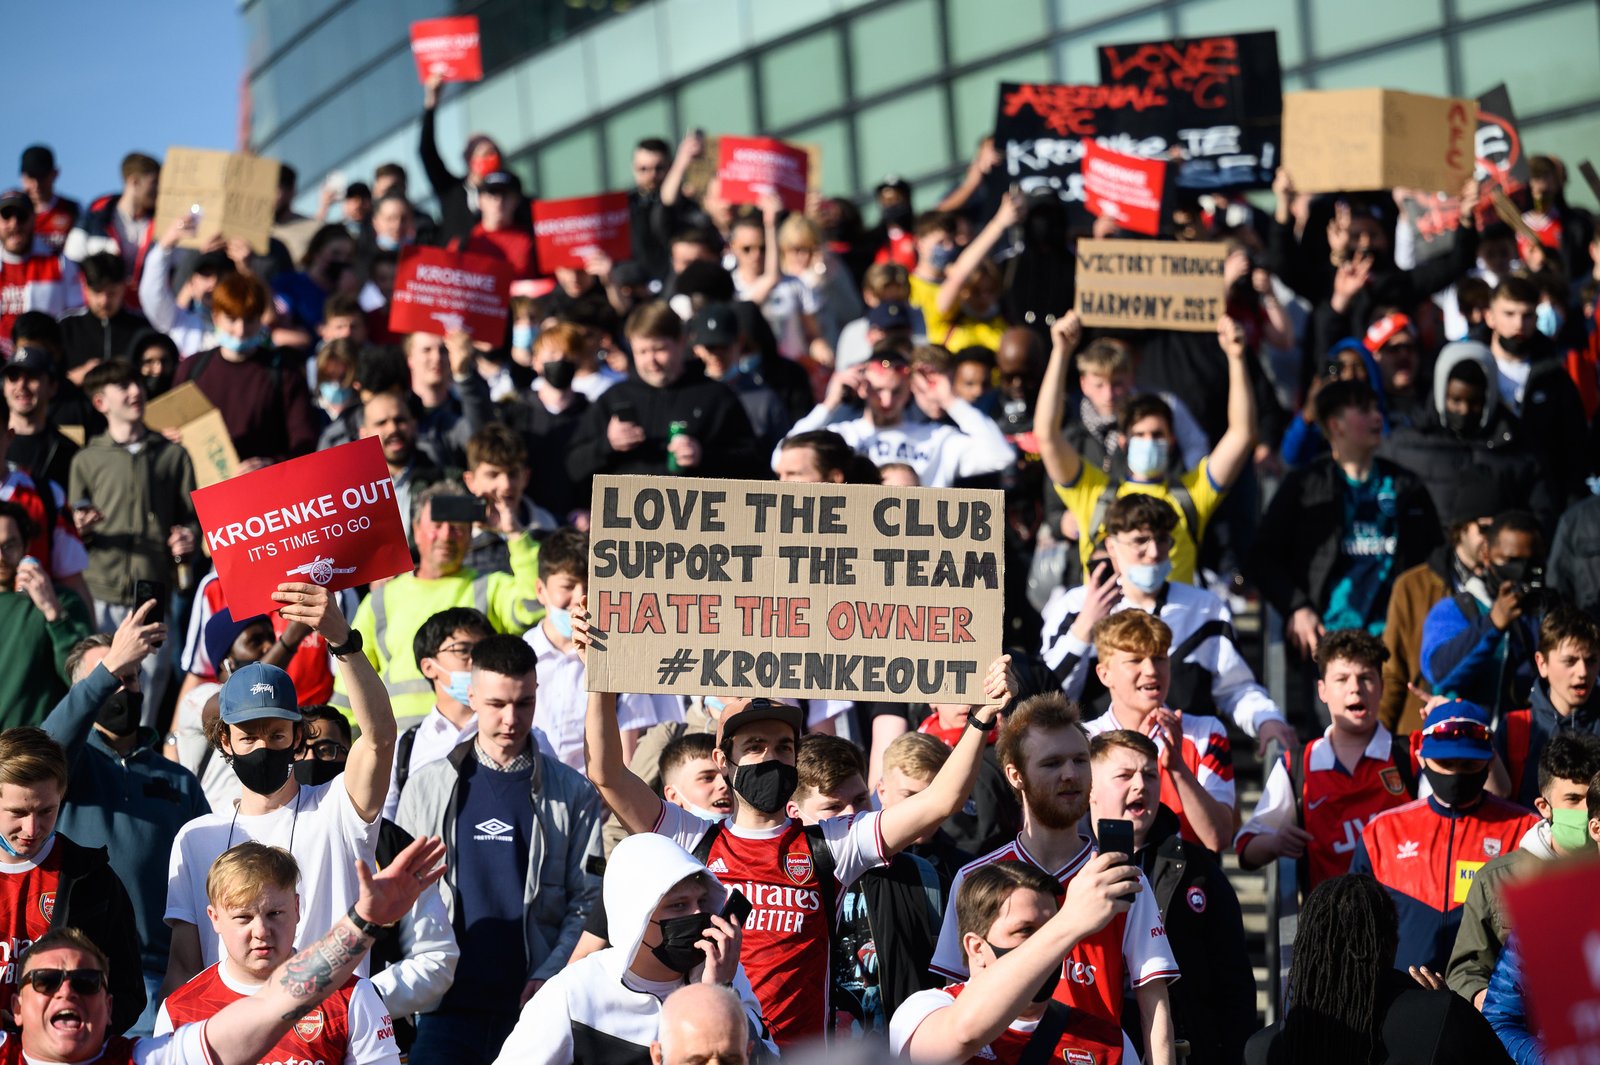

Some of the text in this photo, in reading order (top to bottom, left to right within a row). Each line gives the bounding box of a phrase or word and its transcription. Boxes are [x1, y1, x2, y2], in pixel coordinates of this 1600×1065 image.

[416, 264, 496, 293] KROENKE
[1078, 254, 1153, 274] VICTORY
[208, 478, 391, 550] KROENKE OUT
[603, 487, 992, 541] LOVE THE CLUB
[279, 530, 320, 552] TIME
[323, 524, 343, 540] TO
[347, 516, 371, 533] GO
[593, 540, 998, 589] SUPPORT THE TEAM
[598, 591, 976, 643] HATE THE OWNER
[657, 648, 977, 694] #KROENKEOUT
[726, 881, 820, 911] mirates
[745, 909, 804, 933] BETTER
[1069, 1051, 1091, 1062] Arsenal
